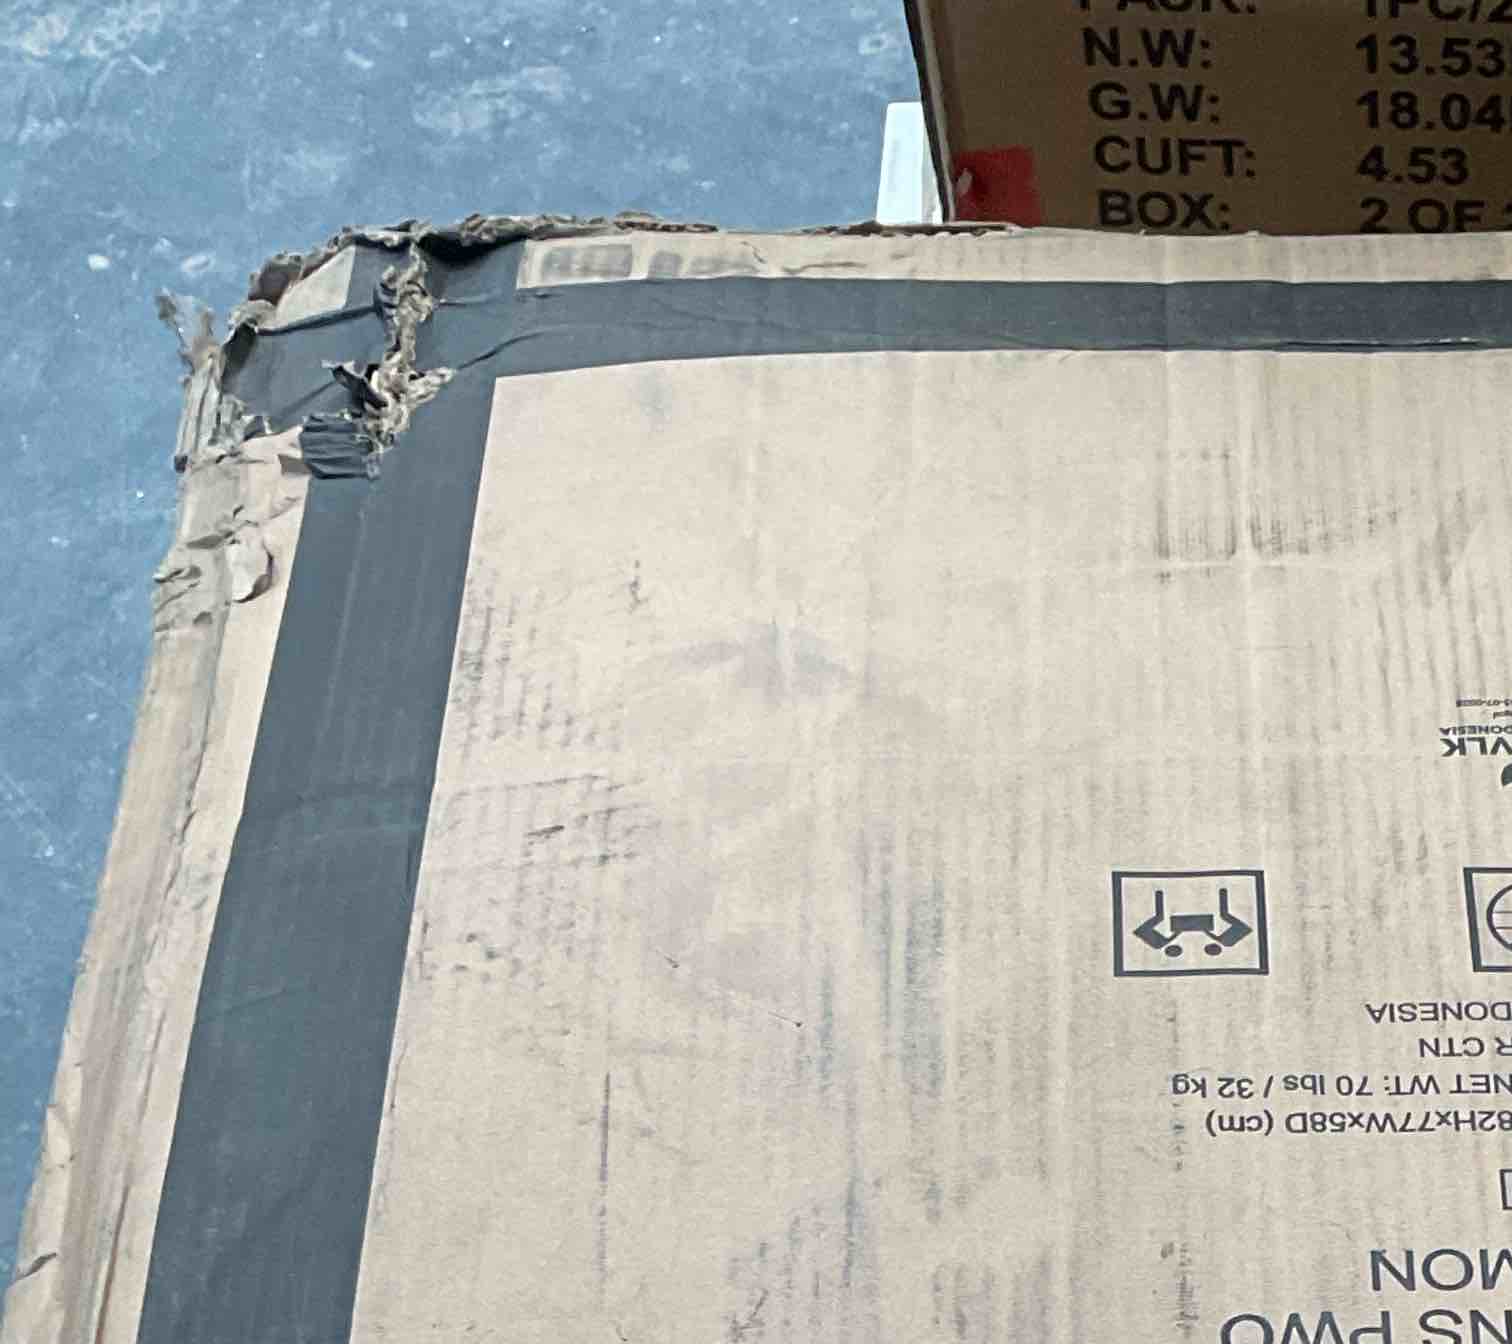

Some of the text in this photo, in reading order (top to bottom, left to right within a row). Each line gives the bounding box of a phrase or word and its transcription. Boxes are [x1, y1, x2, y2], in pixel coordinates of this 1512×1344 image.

[1083, 27, 1212, 68] N.W:
[1089, 81, 1219, 121] G.W:
[1094, 136, 1470, 185] CUFT: 4.53
[1098, 189, 1230, 231] BOX:
[1360, 197, 1390, 233] 2
[1408, 199, 1486, 233] OF
[1418, 1036, 1485, 1058] CTN
[1171, 1073, 1207, 1099] kg
[1217, 1077, 1255, 1100] 32
[1282, 1074, 1326, 1096] lbs
[1335, 1075, 1374, 1097] 70
[1383, 1074, 1441, 1097] WT:
[1205, 1109, 1274, 1138] (cm)
